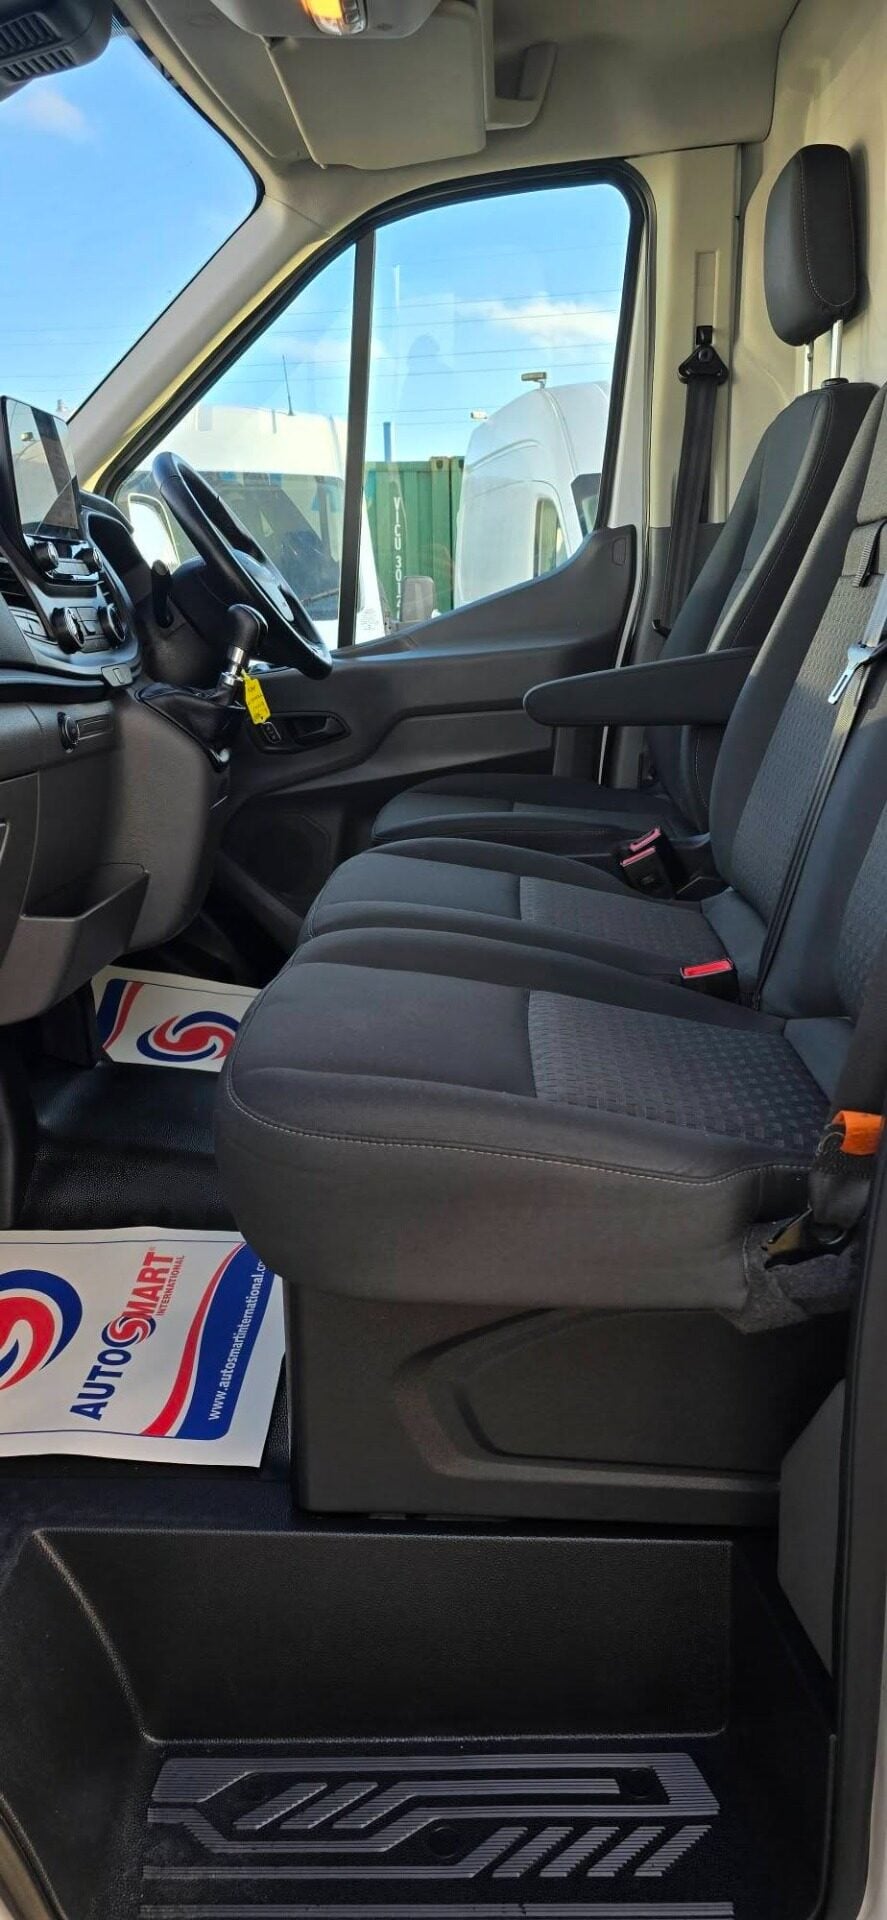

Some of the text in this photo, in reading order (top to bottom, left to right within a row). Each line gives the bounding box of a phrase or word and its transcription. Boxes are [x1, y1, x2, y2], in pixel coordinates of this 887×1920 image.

[70, 1250, 174, 1421] AUTOSMART
[155, 1254, 185, 1317] INTERNATIONAL
[208, 1258, 266, 1421] www.autosmartinternational.co
